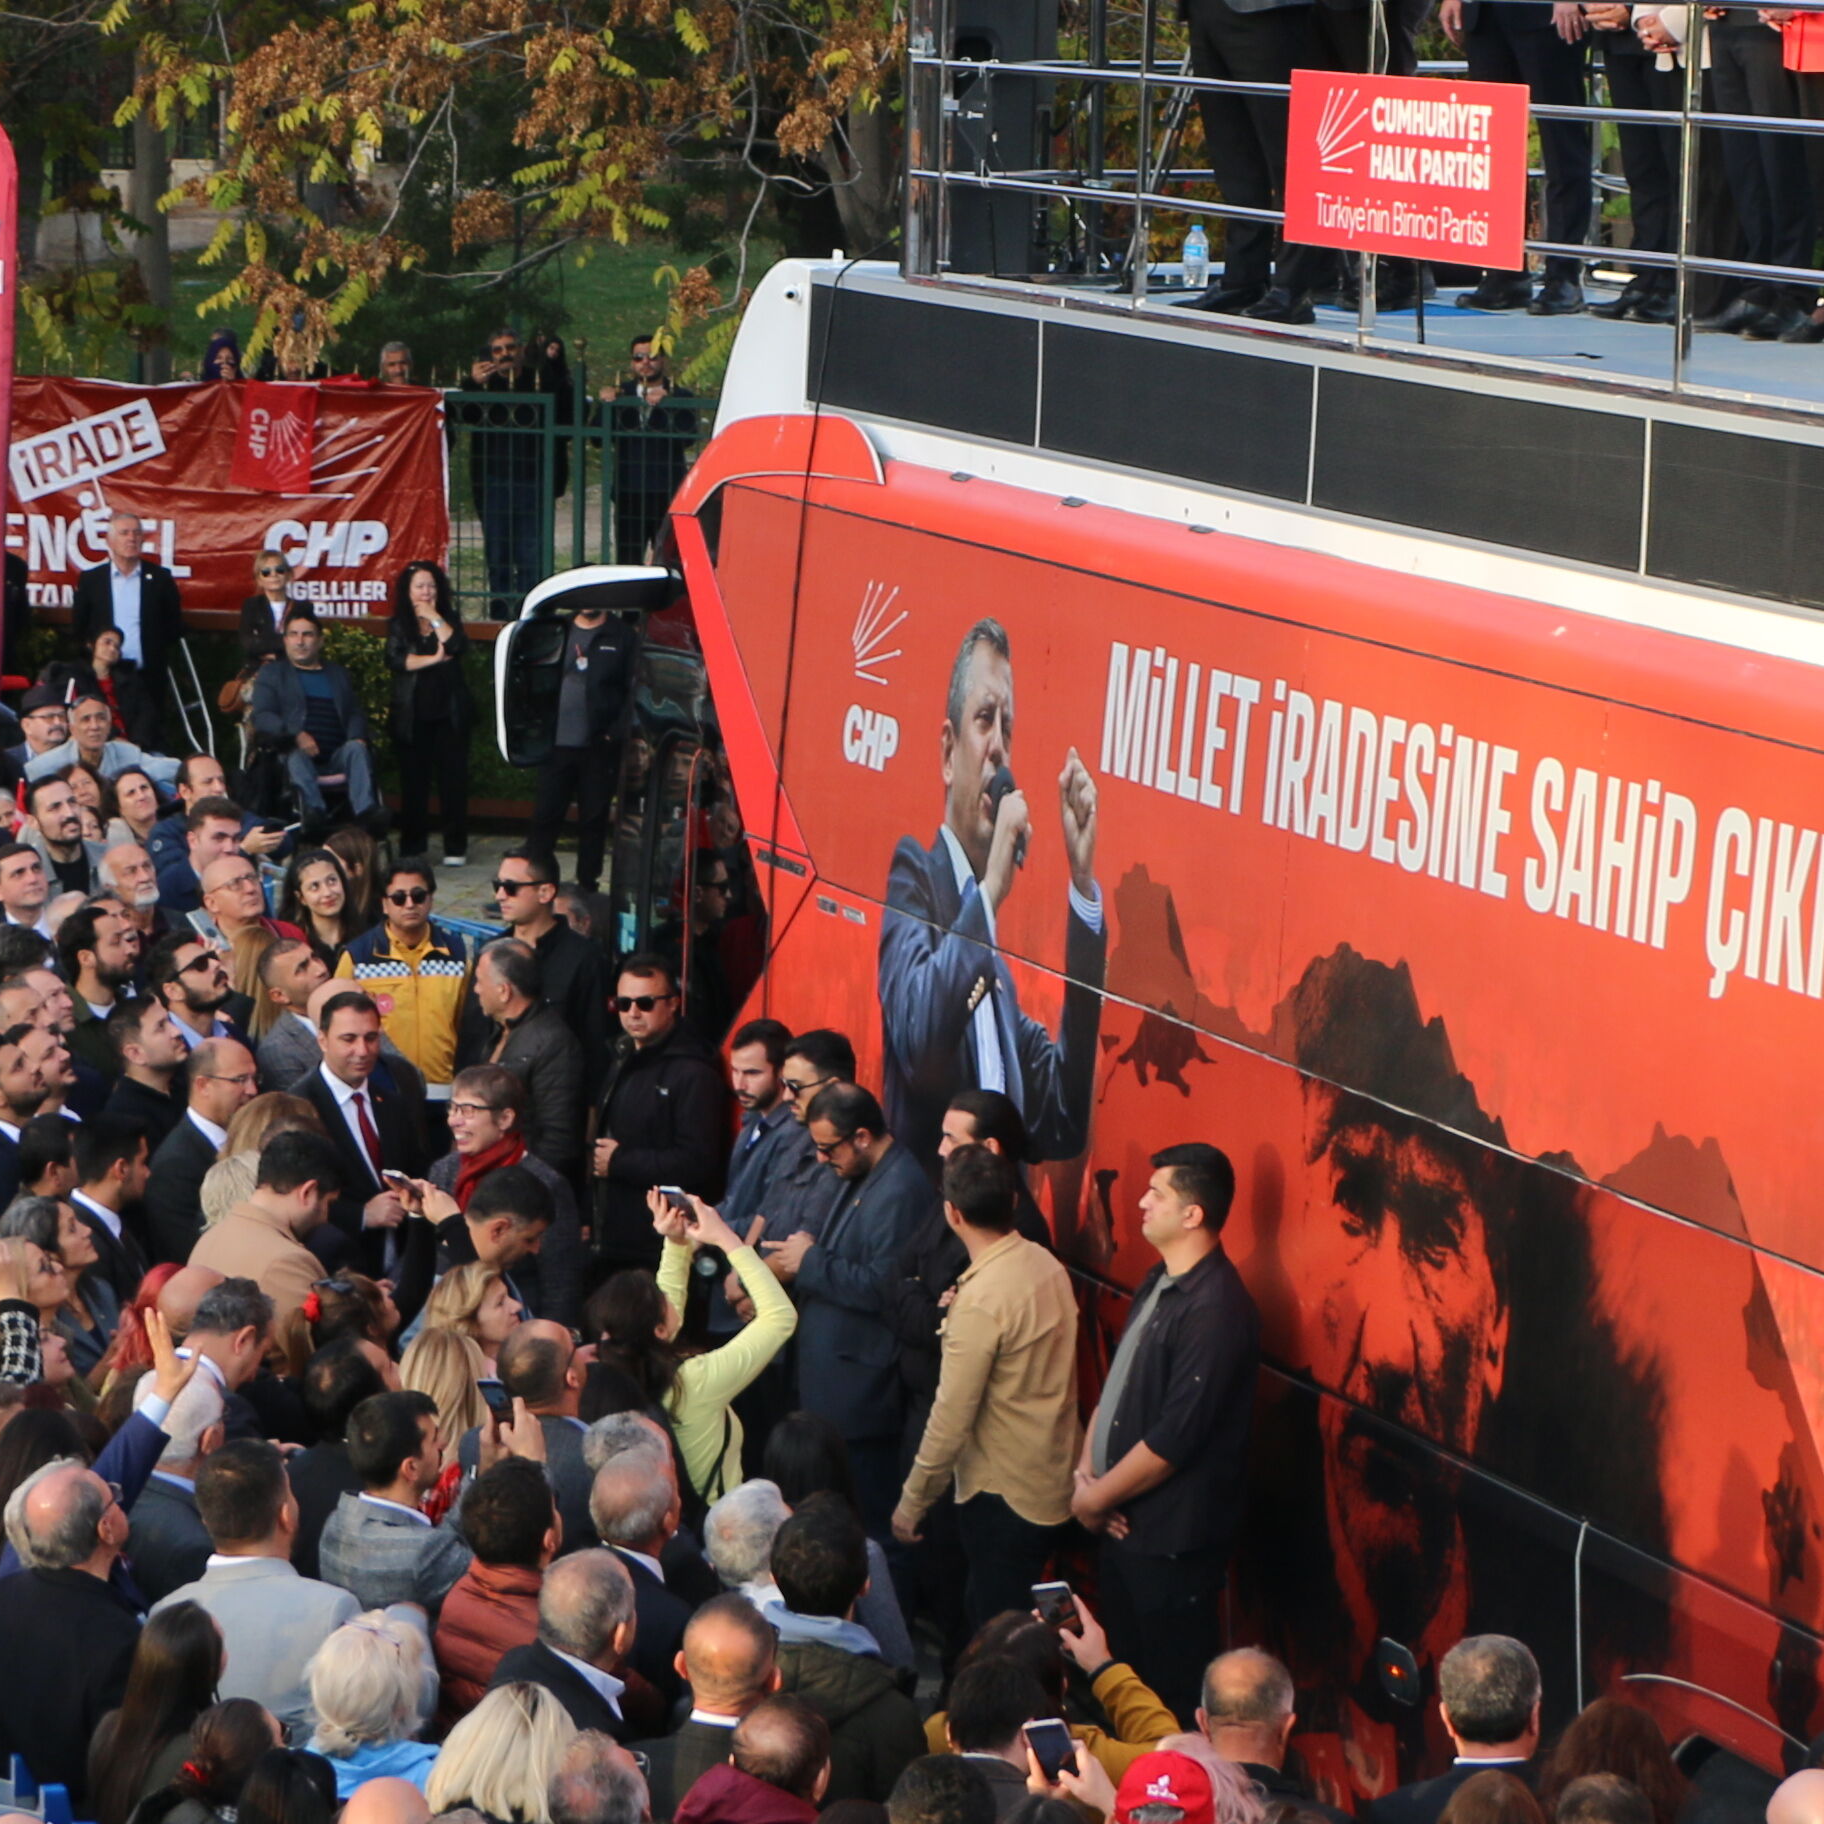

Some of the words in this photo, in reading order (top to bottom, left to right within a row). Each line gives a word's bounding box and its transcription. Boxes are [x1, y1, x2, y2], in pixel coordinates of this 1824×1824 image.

[1371, 93, 1493, 141] CUMHURİYET
[1369, 143, 1416, 183] HALK
[1420, 143, 1491, 191] PARTİSİ
[1316, 192, 1390, 240] Türkiye'nin
[1392, 200, 1438, 241] Birinci
[1440, 206, 1488, 247] Partisi
[249, 407, 270, 460] CHP
[263, 519, 389, 568] CHP
[284, 579, 387, 601] GELLİLER
[842, 703, 901, 773] CHP
[1099, 640, 1261, 816] MİLLET
[1261, 679, 1519, 900] İRADESİNE
[1522, 756, 1697, 950] SAHİP
